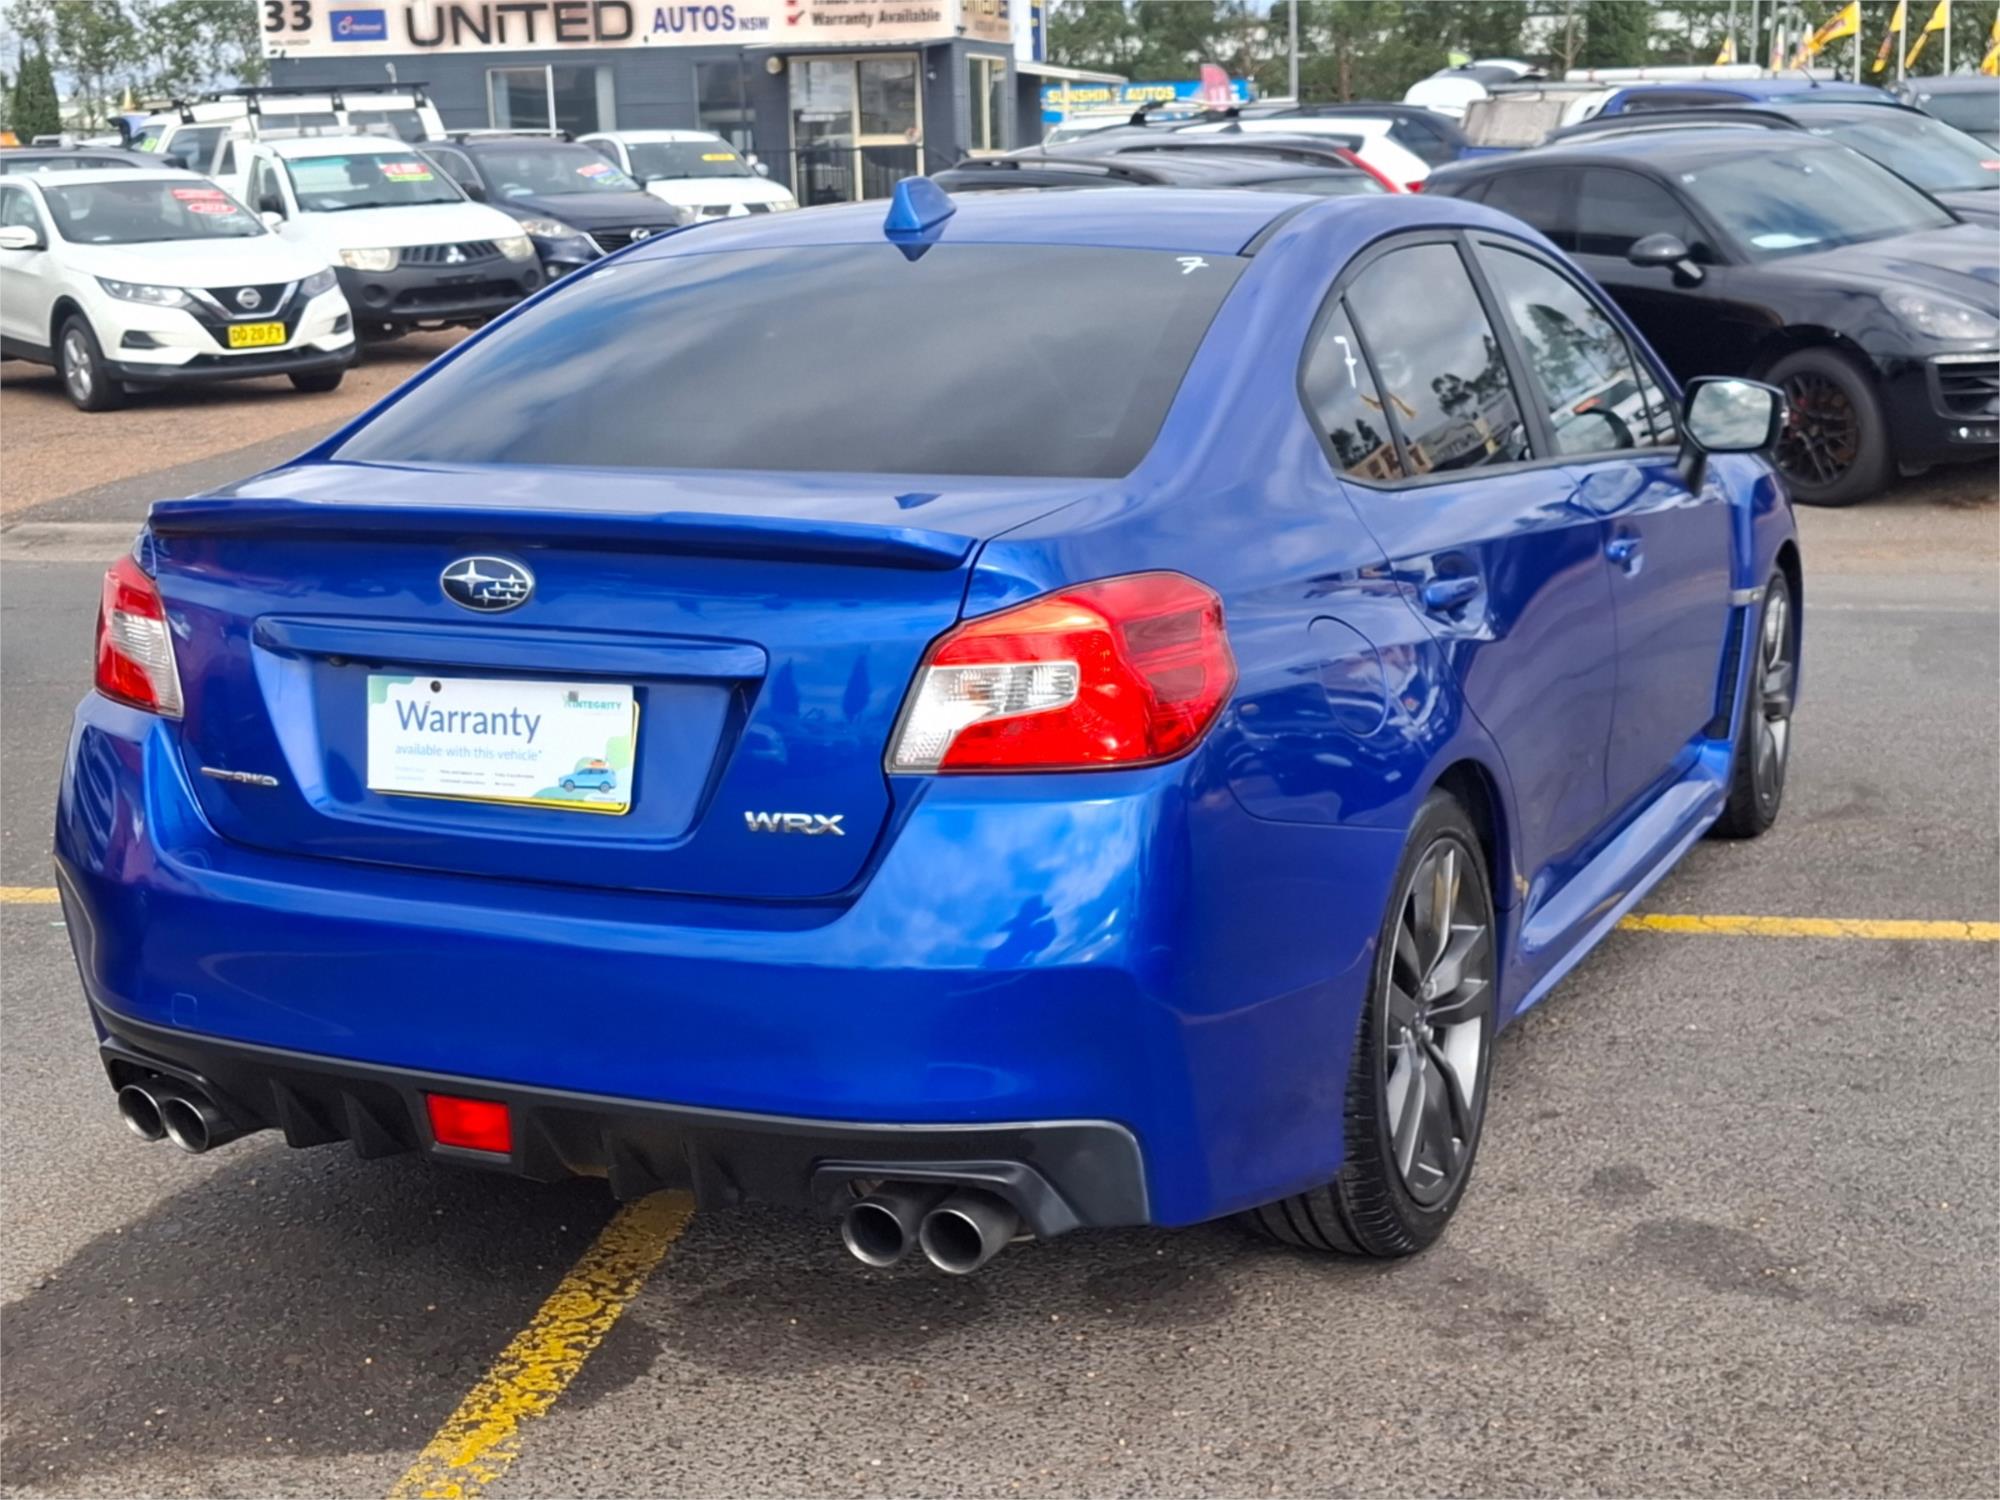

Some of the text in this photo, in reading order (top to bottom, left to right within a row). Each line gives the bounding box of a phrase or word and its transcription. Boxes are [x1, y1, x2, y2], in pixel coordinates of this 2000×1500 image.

[264, 0, 312, 32] 33
[405, 1, 633, 47] UNITED
[653, 6, 769, 33] AUTOS NSW
[812, 9, 941, 28] Warranty Available
[1125, 86, 1176, 101] AUTOS
[395, 699, 541, 744] Warranty
[395, 743, 442, 757] available
[446, 745, 471, 758] with
[473, 746, 495, 759] this
[744, 811, 845, 836] WRX
